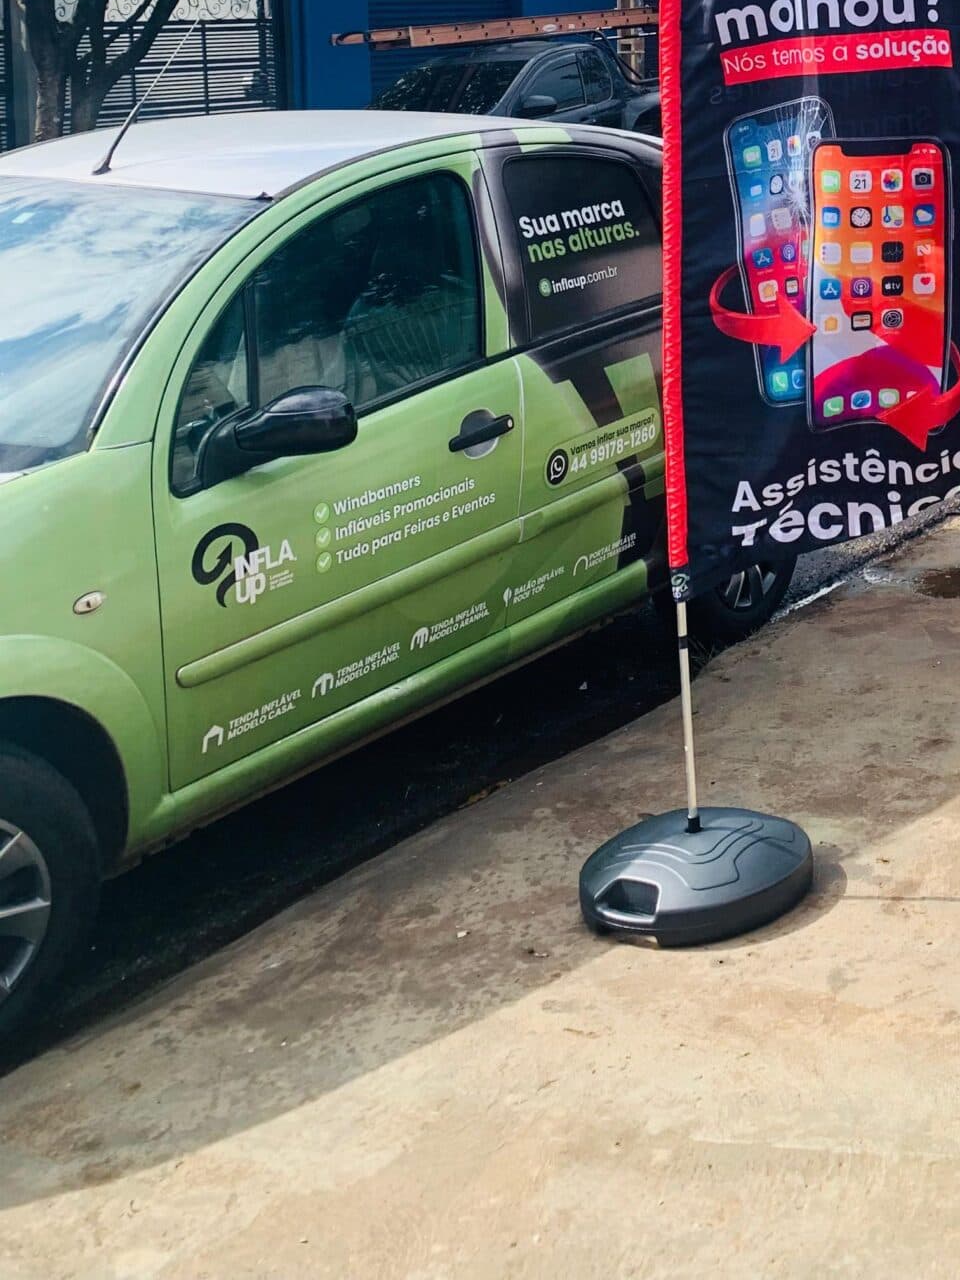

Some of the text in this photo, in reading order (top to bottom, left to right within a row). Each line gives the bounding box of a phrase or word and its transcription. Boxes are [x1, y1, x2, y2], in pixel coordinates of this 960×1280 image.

[723, 35, 950, 75] Nós temos a solução
[854, 178, 867, 190] 21
[519, 200, 626, 238] Sua marca
[527, 221, 640, 263] nas alturas.
[551, 265, 619, 294] inflaup.com.br
[570, 439, 596, 456] Vamos
[570, 453, 588, 473] 44
[333, 475, 422, 516] Windbanners
[335, 477, 476, 541] Infláveis Promocionais
[336, 492, 497, 564] Tudo para Feiras e Eventos
[227, 715, 267, 741] MODELO
[229, 708, 260, 730] TENDA
